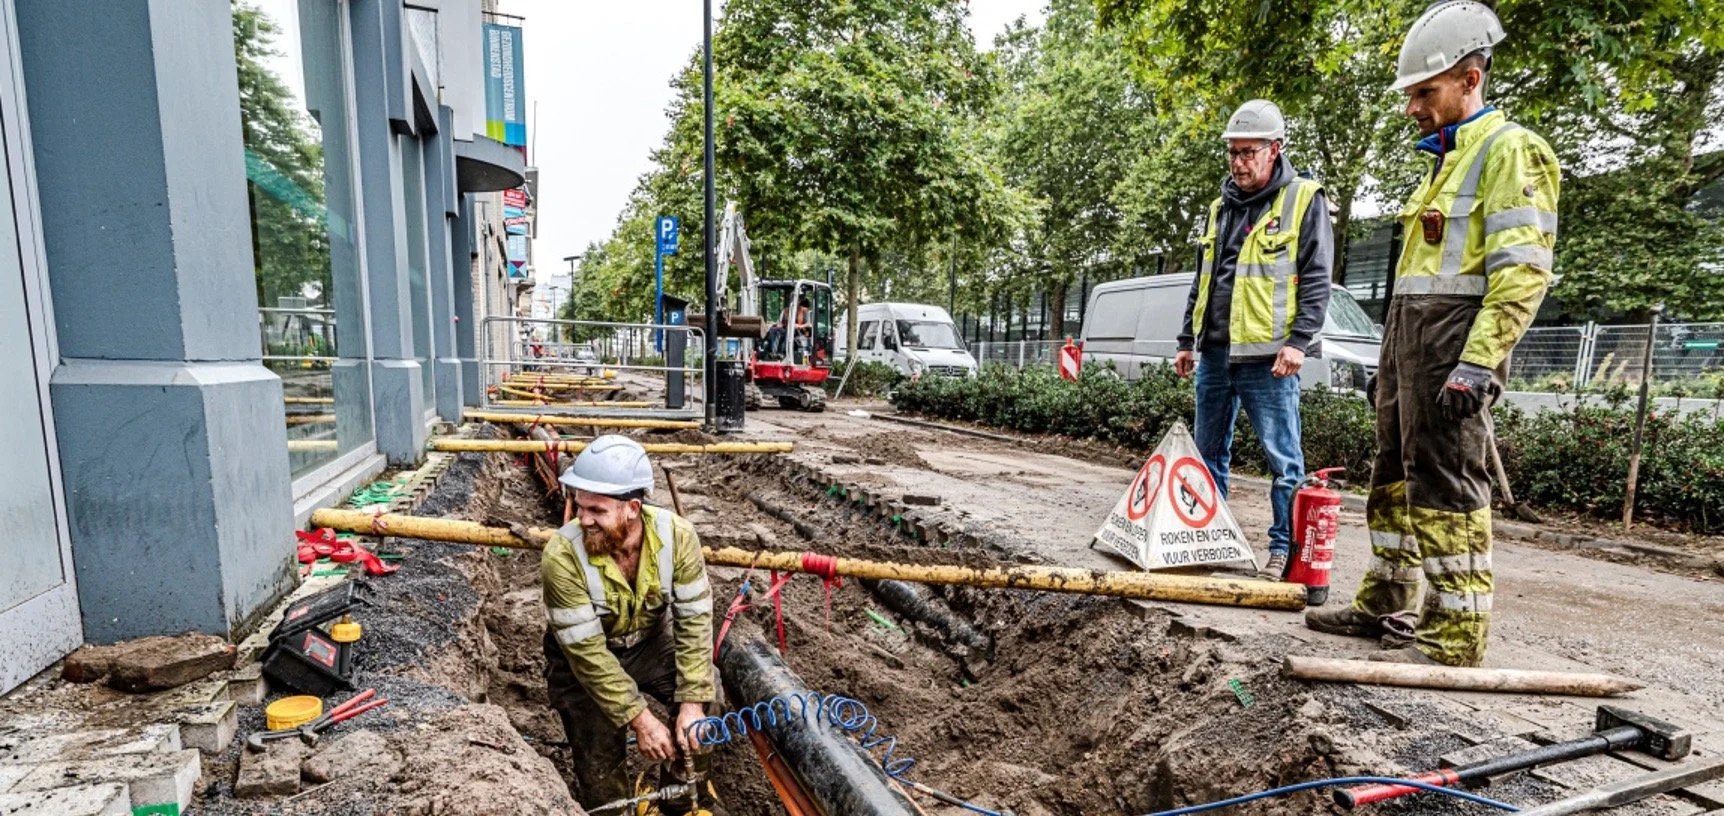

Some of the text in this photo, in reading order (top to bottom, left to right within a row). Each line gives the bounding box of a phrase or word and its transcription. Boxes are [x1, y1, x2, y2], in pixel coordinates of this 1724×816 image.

[661, 219, 673, 238] P
[671, 311, 679, 323] P
[1160, 528, 1237, 546] ROKEN EN OPEN
[1162, 546, 1241, 564] VUUR VERBODEN
